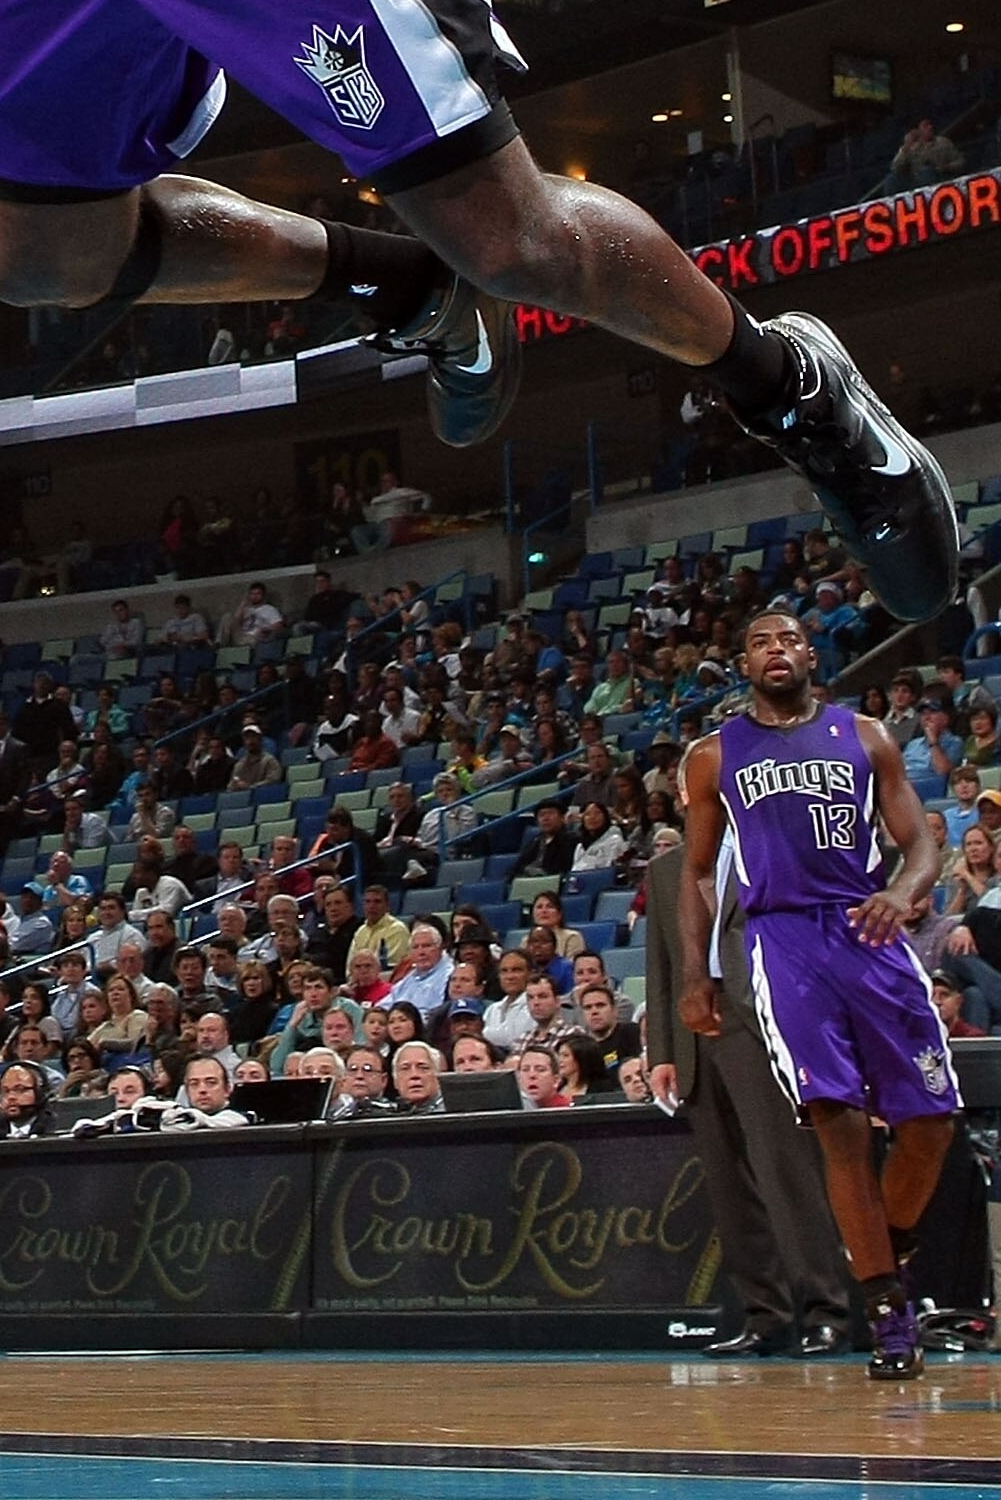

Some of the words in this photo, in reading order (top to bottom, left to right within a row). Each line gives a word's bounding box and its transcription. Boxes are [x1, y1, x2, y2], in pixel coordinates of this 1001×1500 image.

[735, 758, 855, 810] Kings
[808, 803, 857, 850] 13
[85, 1160, 291, 1299] Royal
[333, 1157, 494, 1289] Crown
[454, 1141, 704, 1298] Royal
